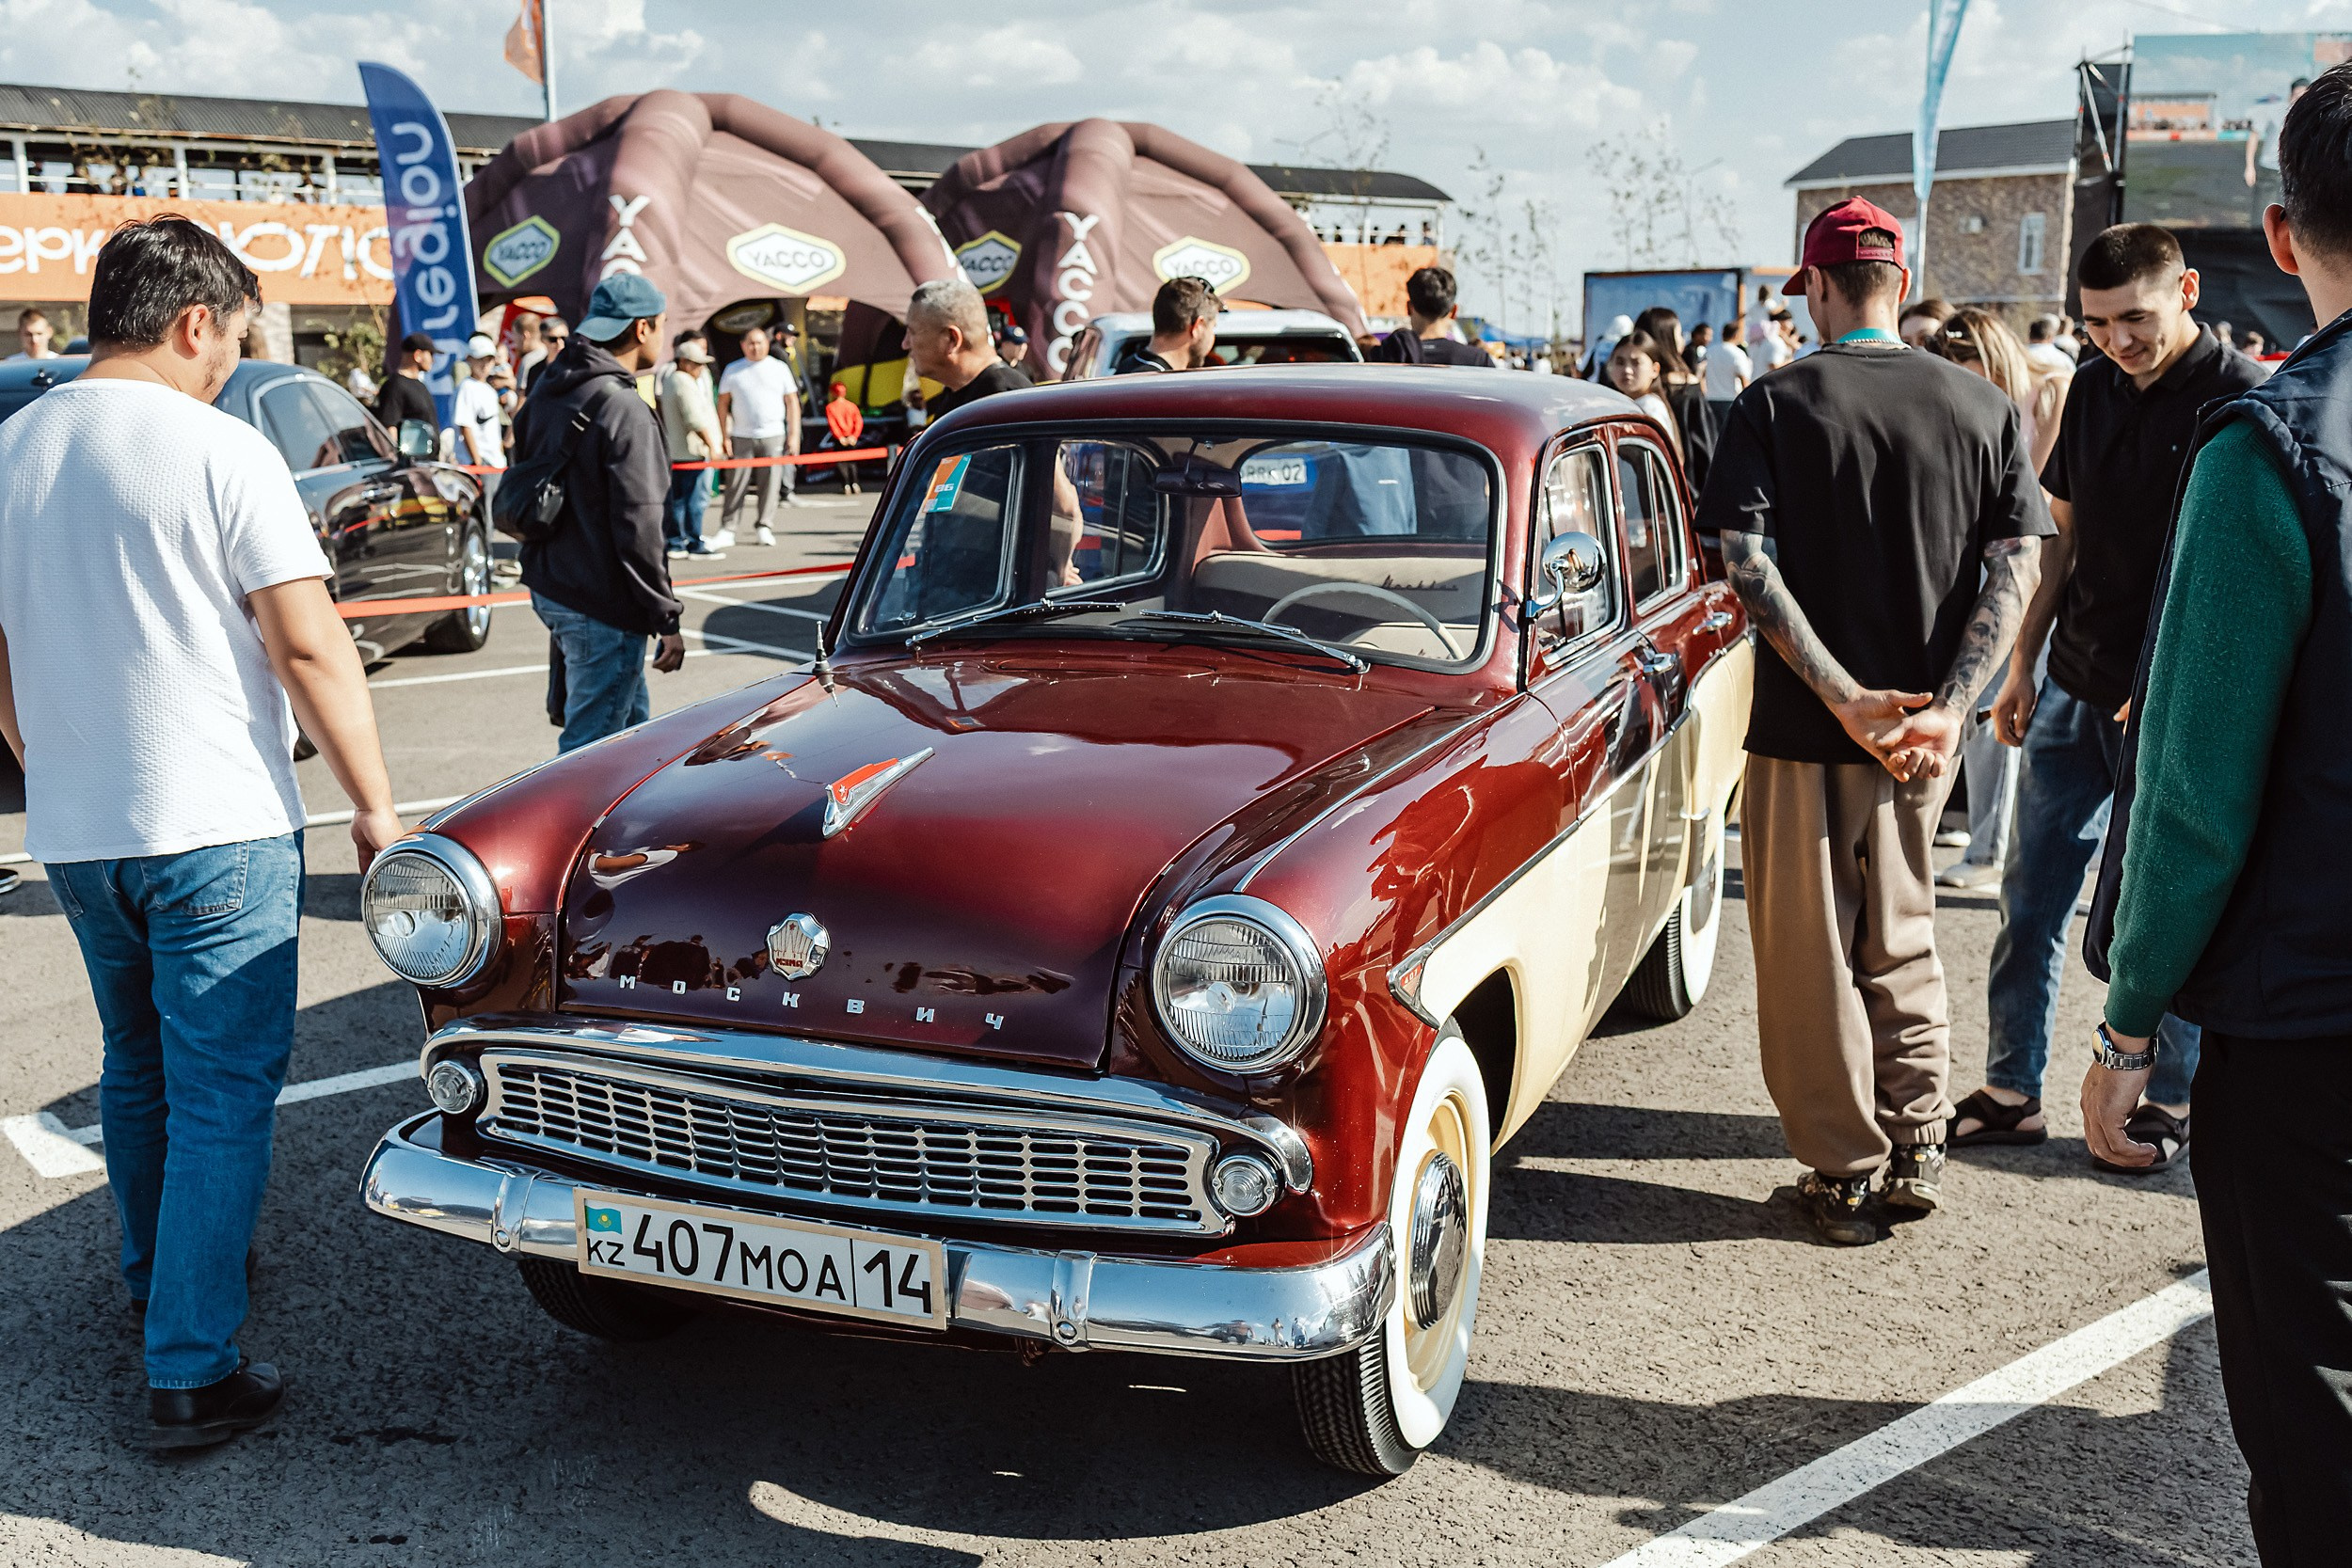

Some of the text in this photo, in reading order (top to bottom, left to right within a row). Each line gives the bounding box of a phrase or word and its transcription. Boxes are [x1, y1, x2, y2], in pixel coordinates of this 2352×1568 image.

[749, 249, 825, 269] YACCO
[619, 974, 1005, 1031] МОСКВИЧ
[587, 1237, 626, 1267] KZ
[864, 1248, 933, 1314] 14
